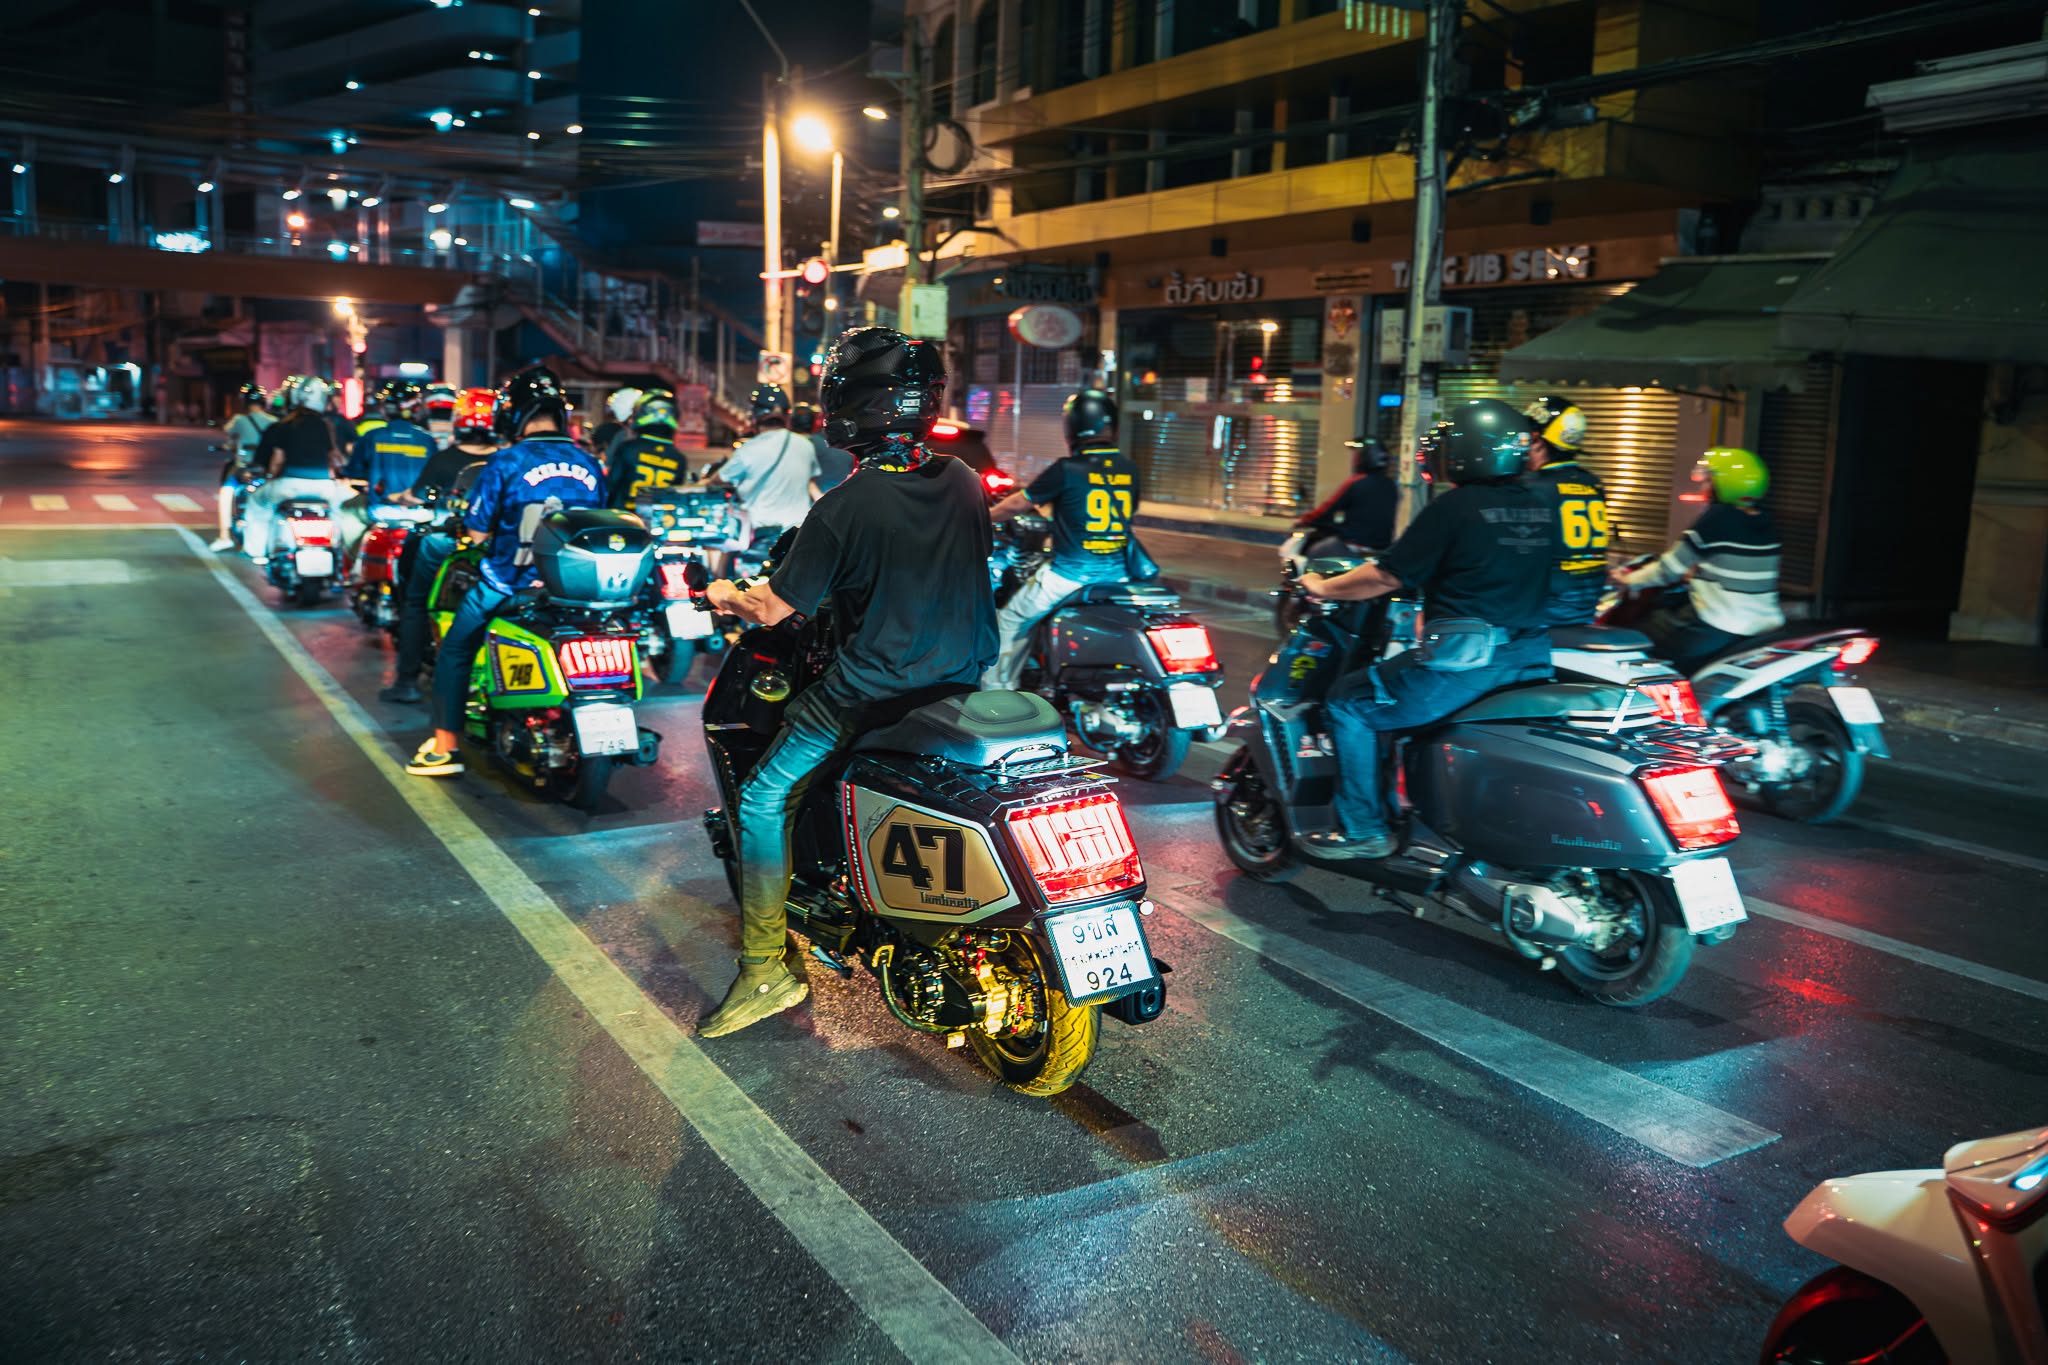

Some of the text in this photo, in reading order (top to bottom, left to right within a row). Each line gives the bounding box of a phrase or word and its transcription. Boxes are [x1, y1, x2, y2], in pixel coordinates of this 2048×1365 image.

[1392, 256, 1458, 289] TG
[1560, 500, 1608, 548] 69
[883, 822, 966, 894] 47
[1086, 962, 1133, 991] 924
